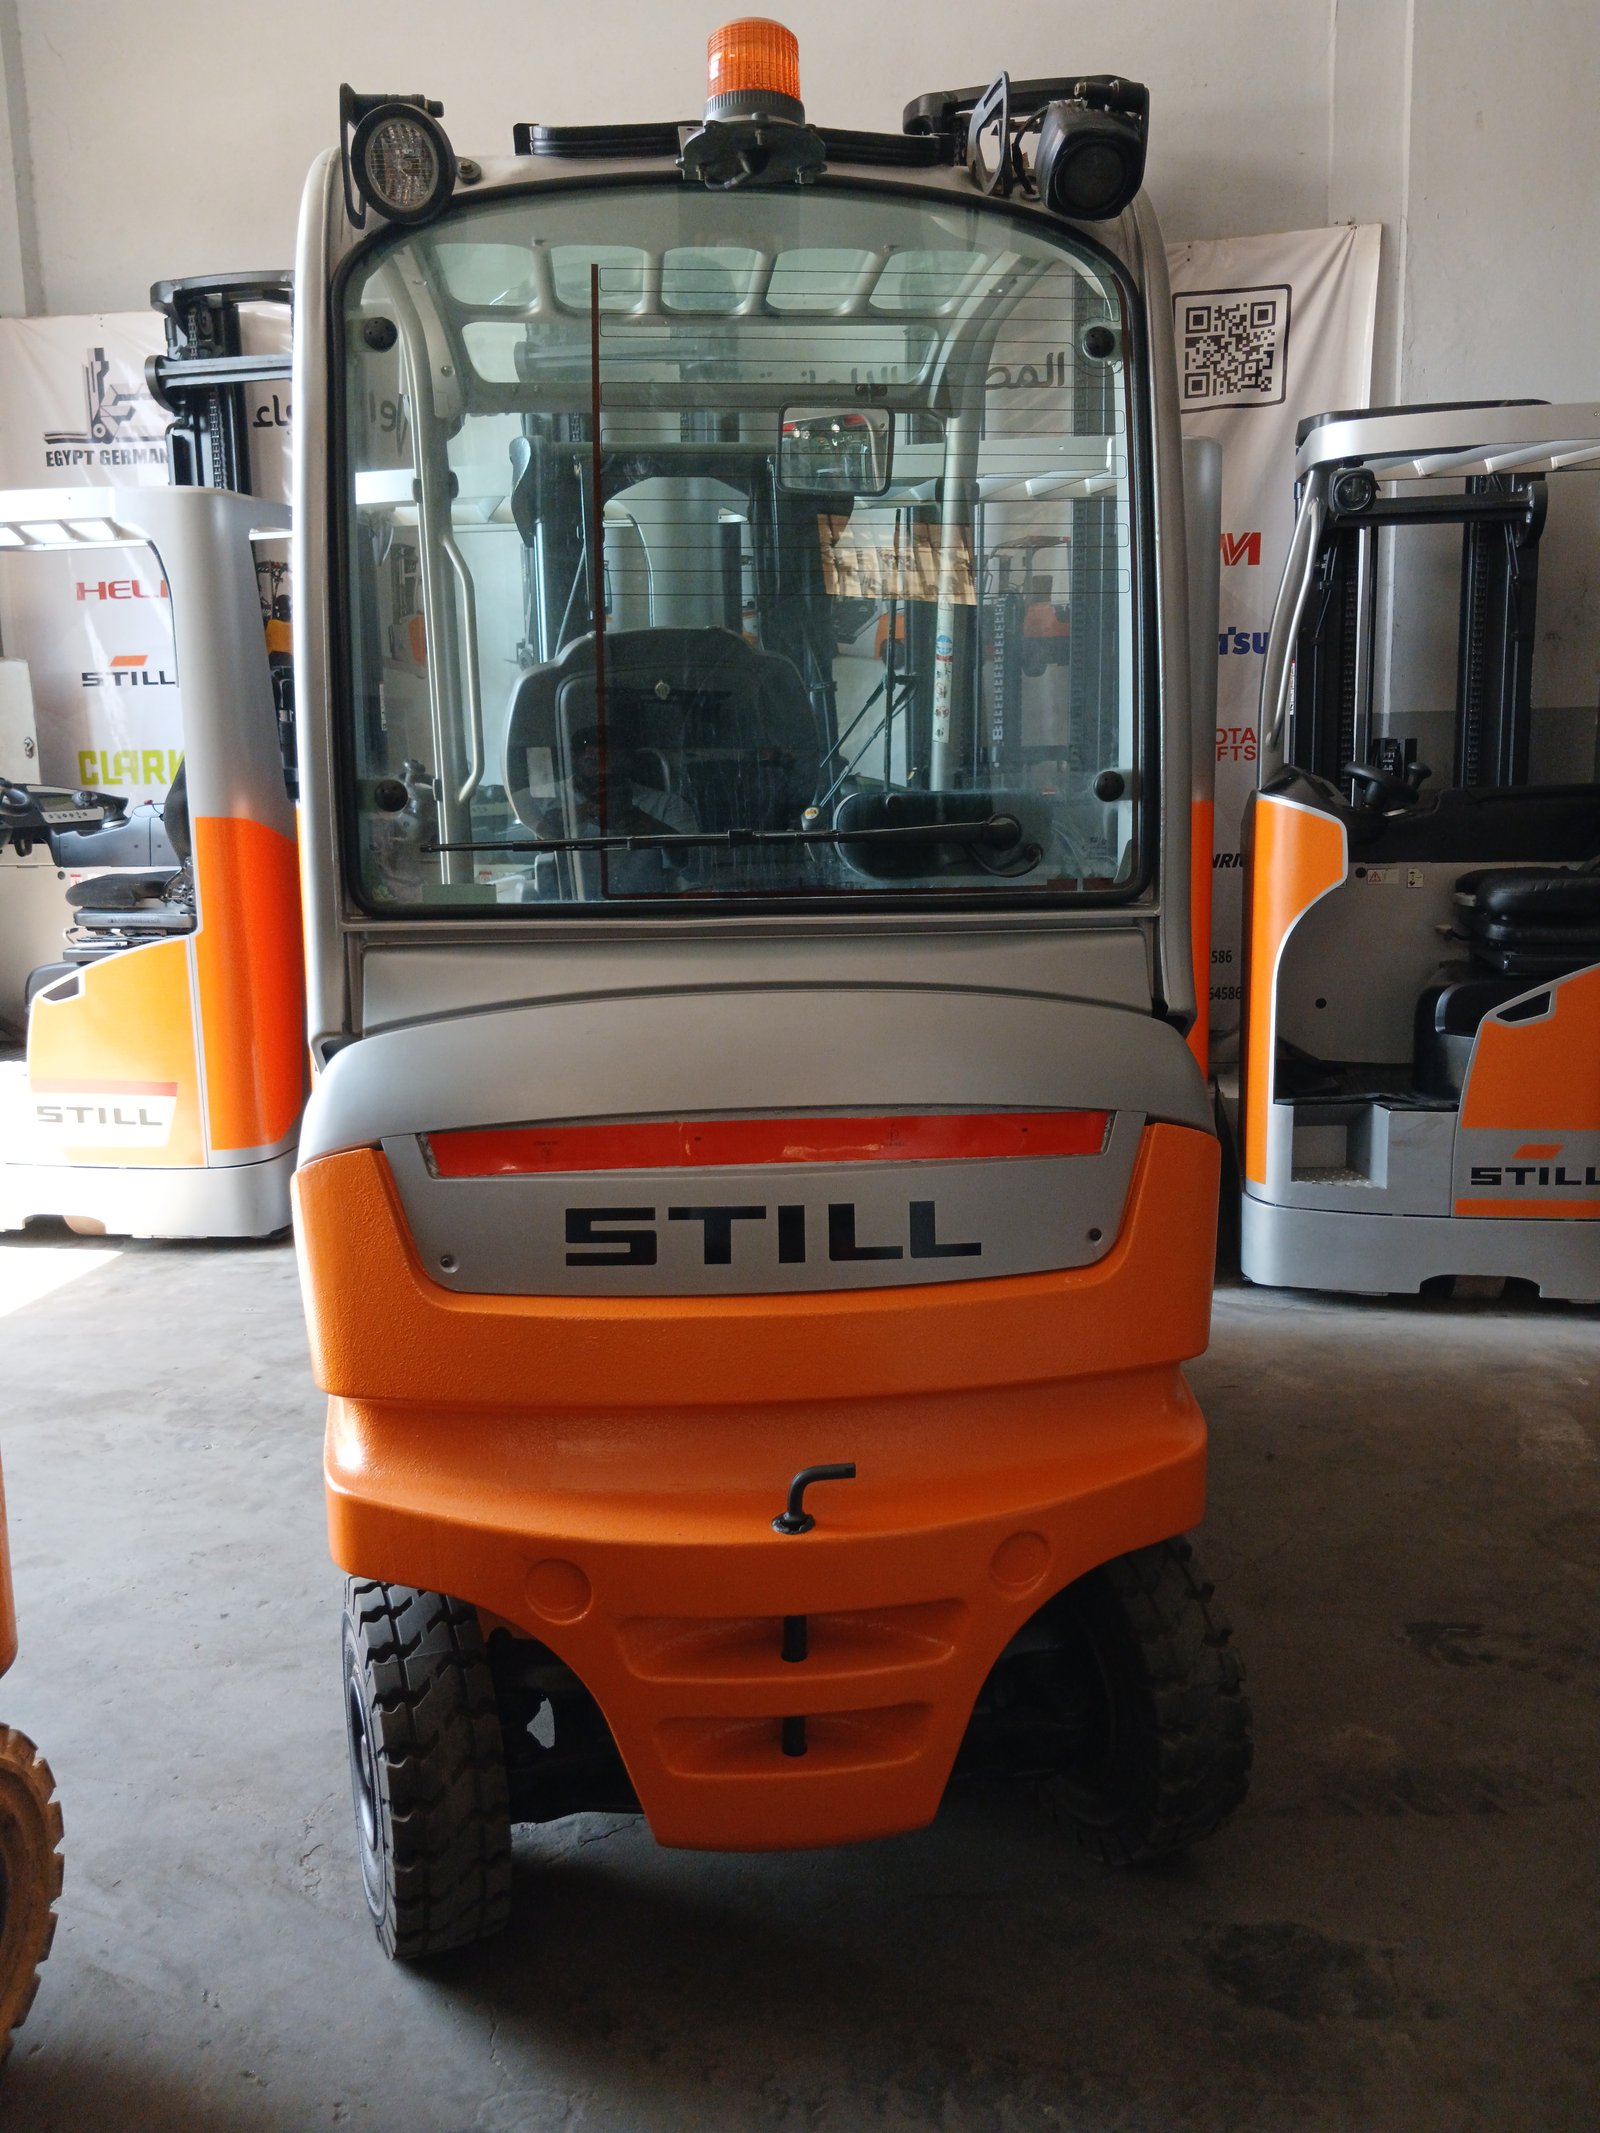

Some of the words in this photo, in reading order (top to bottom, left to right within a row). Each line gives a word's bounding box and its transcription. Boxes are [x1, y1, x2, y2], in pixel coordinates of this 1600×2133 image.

[45, 449, 95, 468] EGYPT
[82, 670, 176, 687] STILL
[1216, 745, 1257, 762] FTS
[1211, 949, 1233, 964] 586
[36, 1104, 164, 1126] STILL
[565, 1200, 982, 1267] STILL
